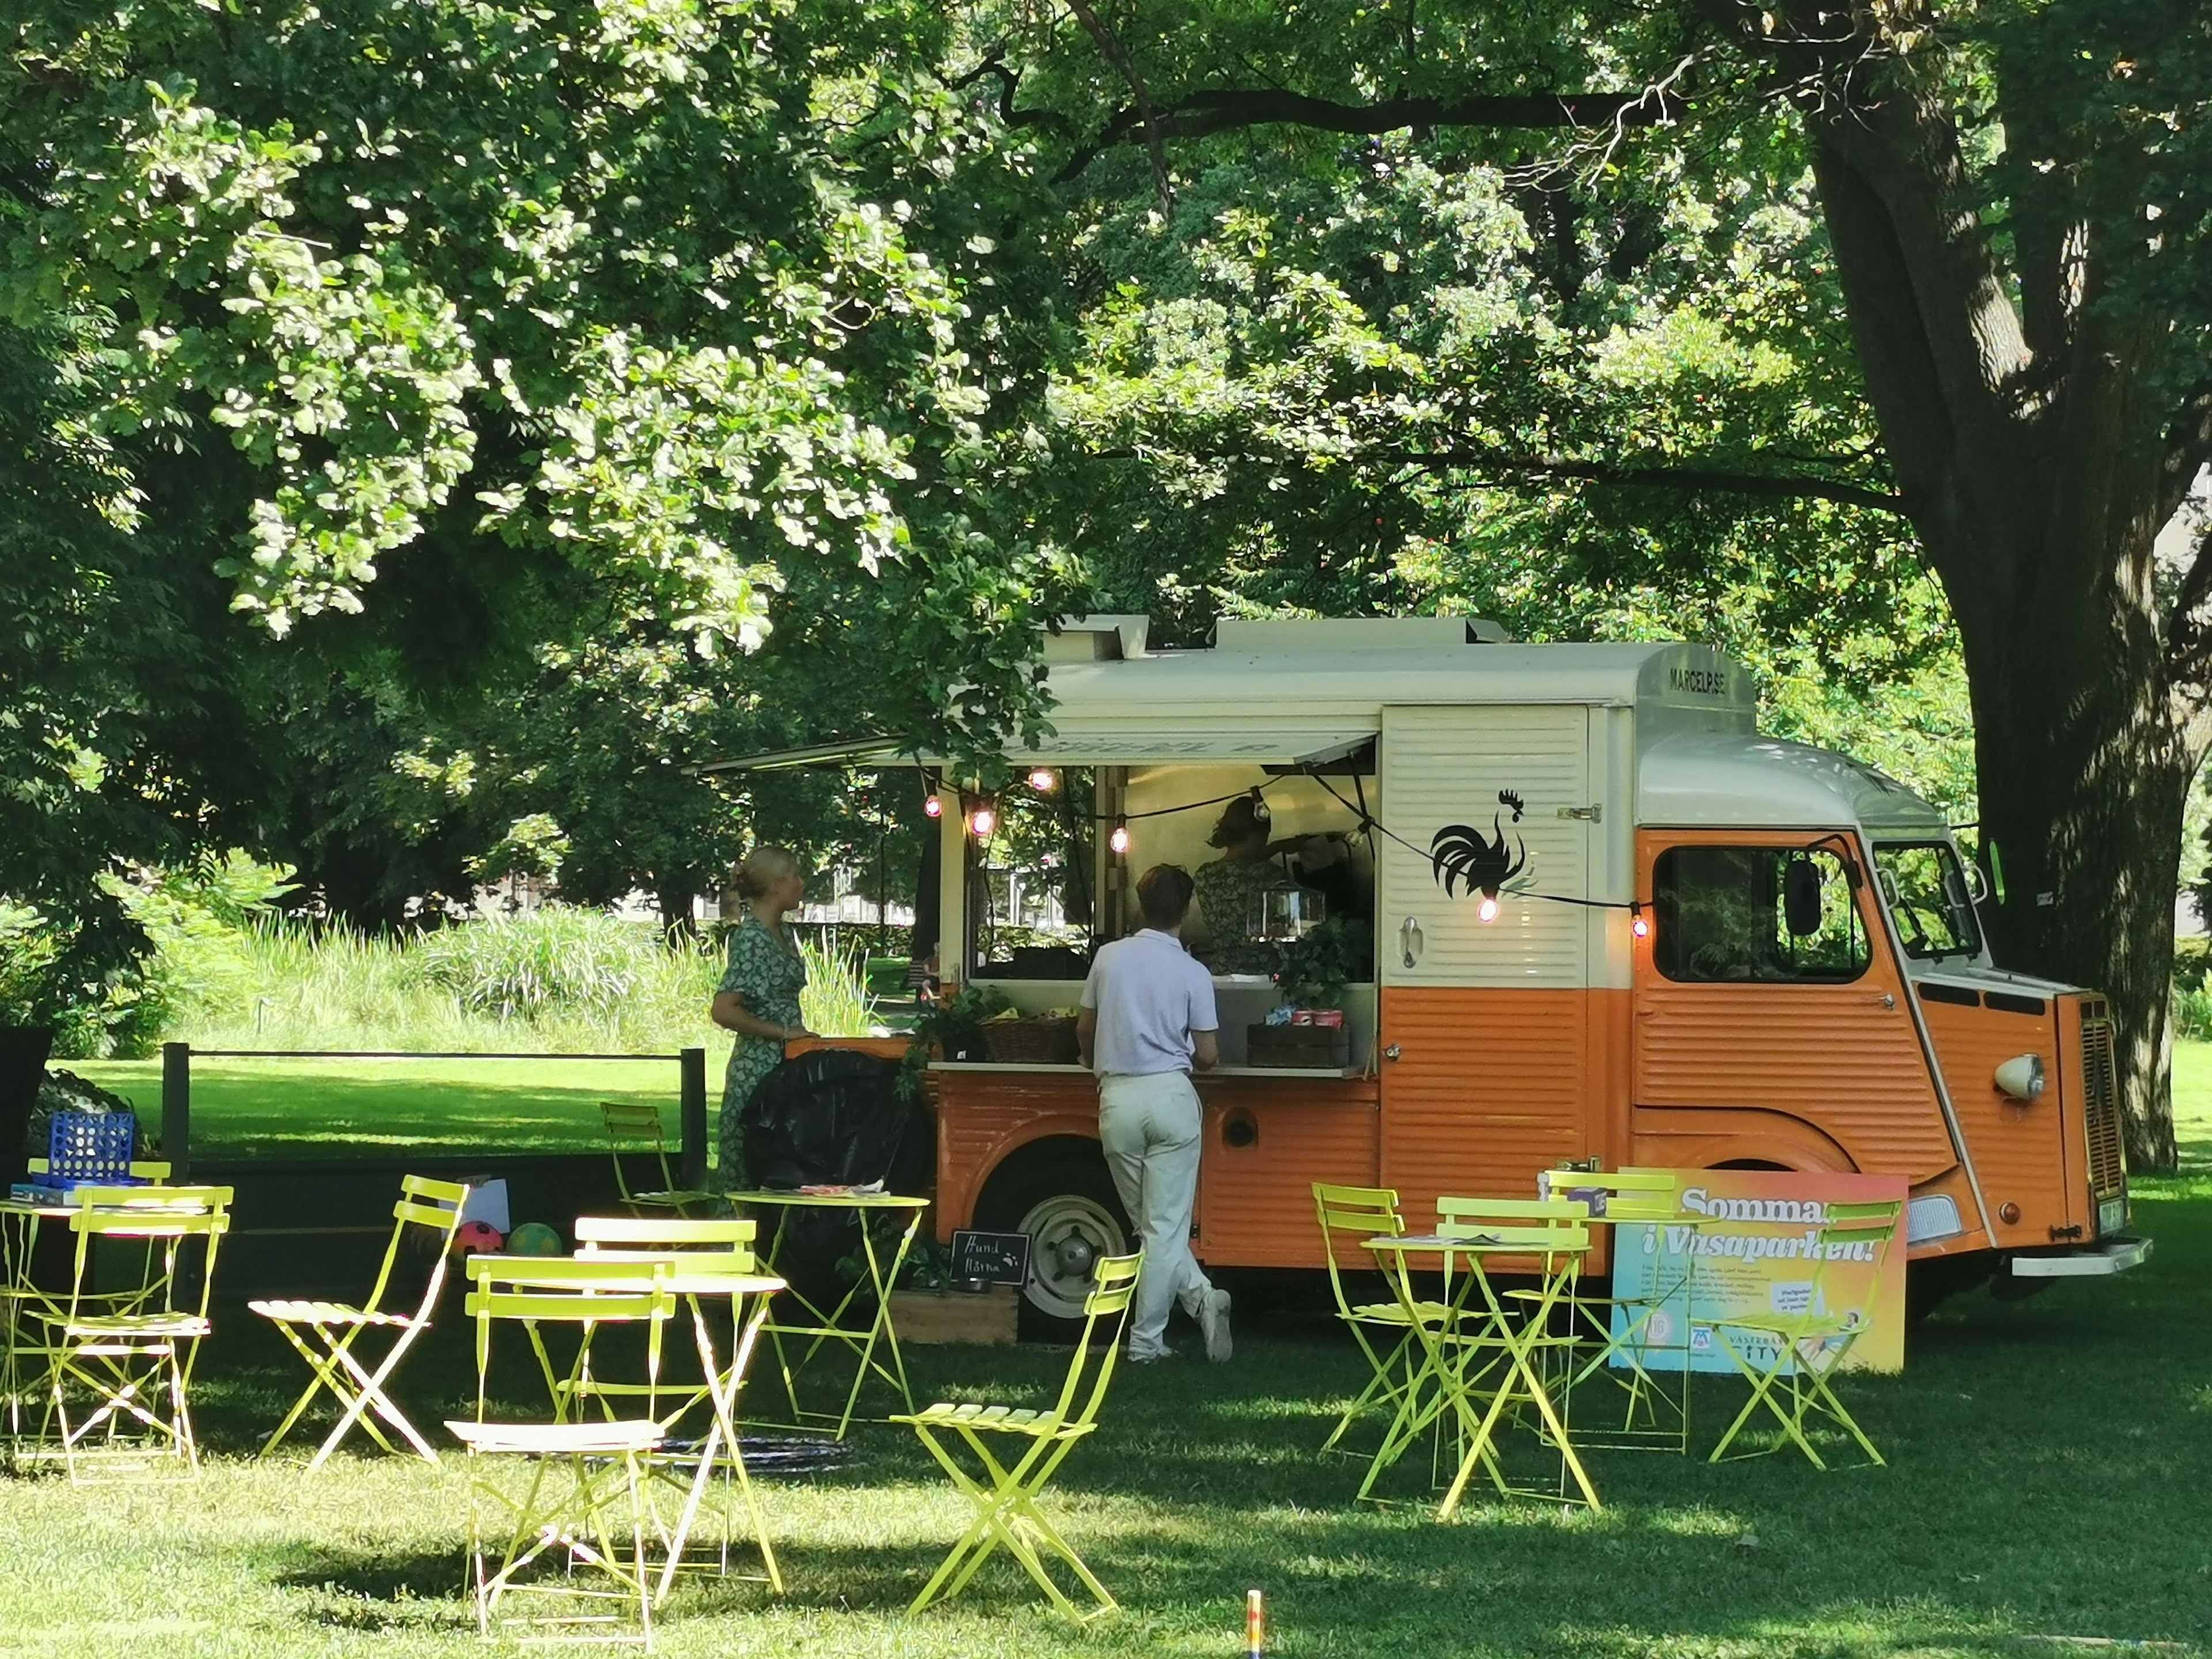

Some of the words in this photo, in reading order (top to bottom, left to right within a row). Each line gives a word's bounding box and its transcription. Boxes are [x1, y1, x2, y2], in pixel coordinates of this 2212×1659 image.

[1681, 1188, 1837, 1224] Somma
[964, 1235, 999, 1254] Hund
[1642, 1225, 1657, 1254] i
[1665, 1226, 1876, 1263] Vasaparken!
